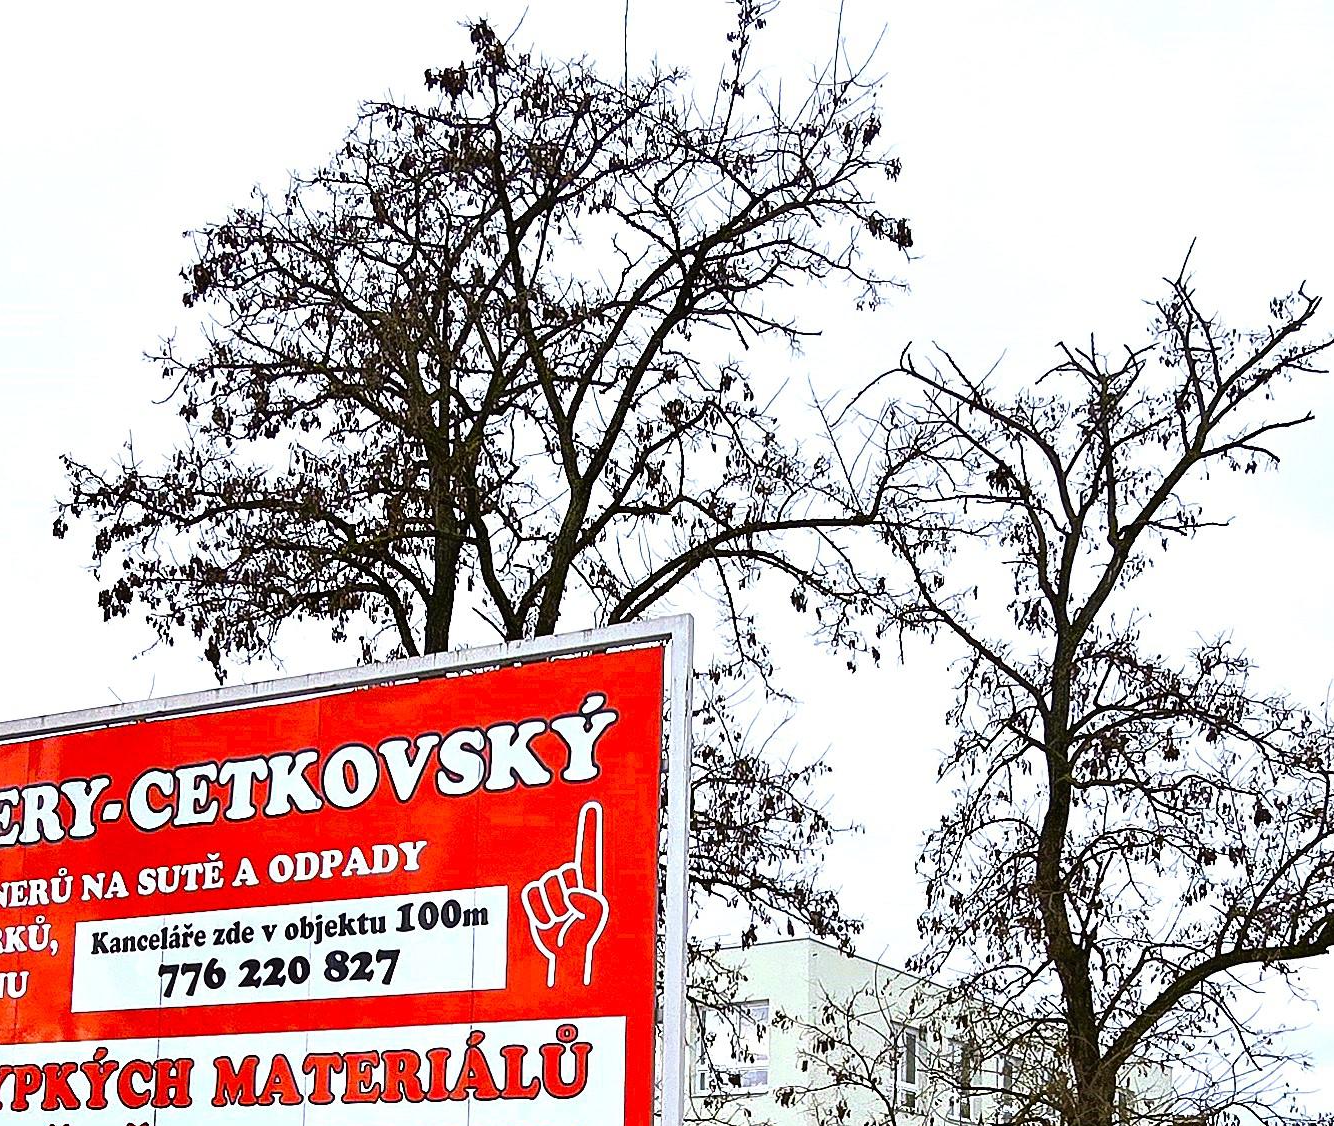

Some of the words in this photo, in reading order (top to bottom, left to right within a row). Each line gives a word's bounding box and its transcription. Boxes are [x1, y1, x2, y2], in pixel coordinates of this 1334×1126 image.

[81, 870, 128, 902] NA
[137, 852, 224, 894] SUTĚ
[232, 861, 260, 889] A
[267, 840, 428, 885] ODPADY
[91, 922, 206, 956] Kanceláře
[212, 926, 253, 947] zde
[261, 928, 275, 943] v
[284, 911, 386, 947] objektu
[394, 900, 488, 934] 100m
[158, 959, 227, 998] 776
[238, 955, 311, 988] 220
[323, 948, 401, 986] 827
[211, 1024, 593, 1108] MATERIÁLŮ
